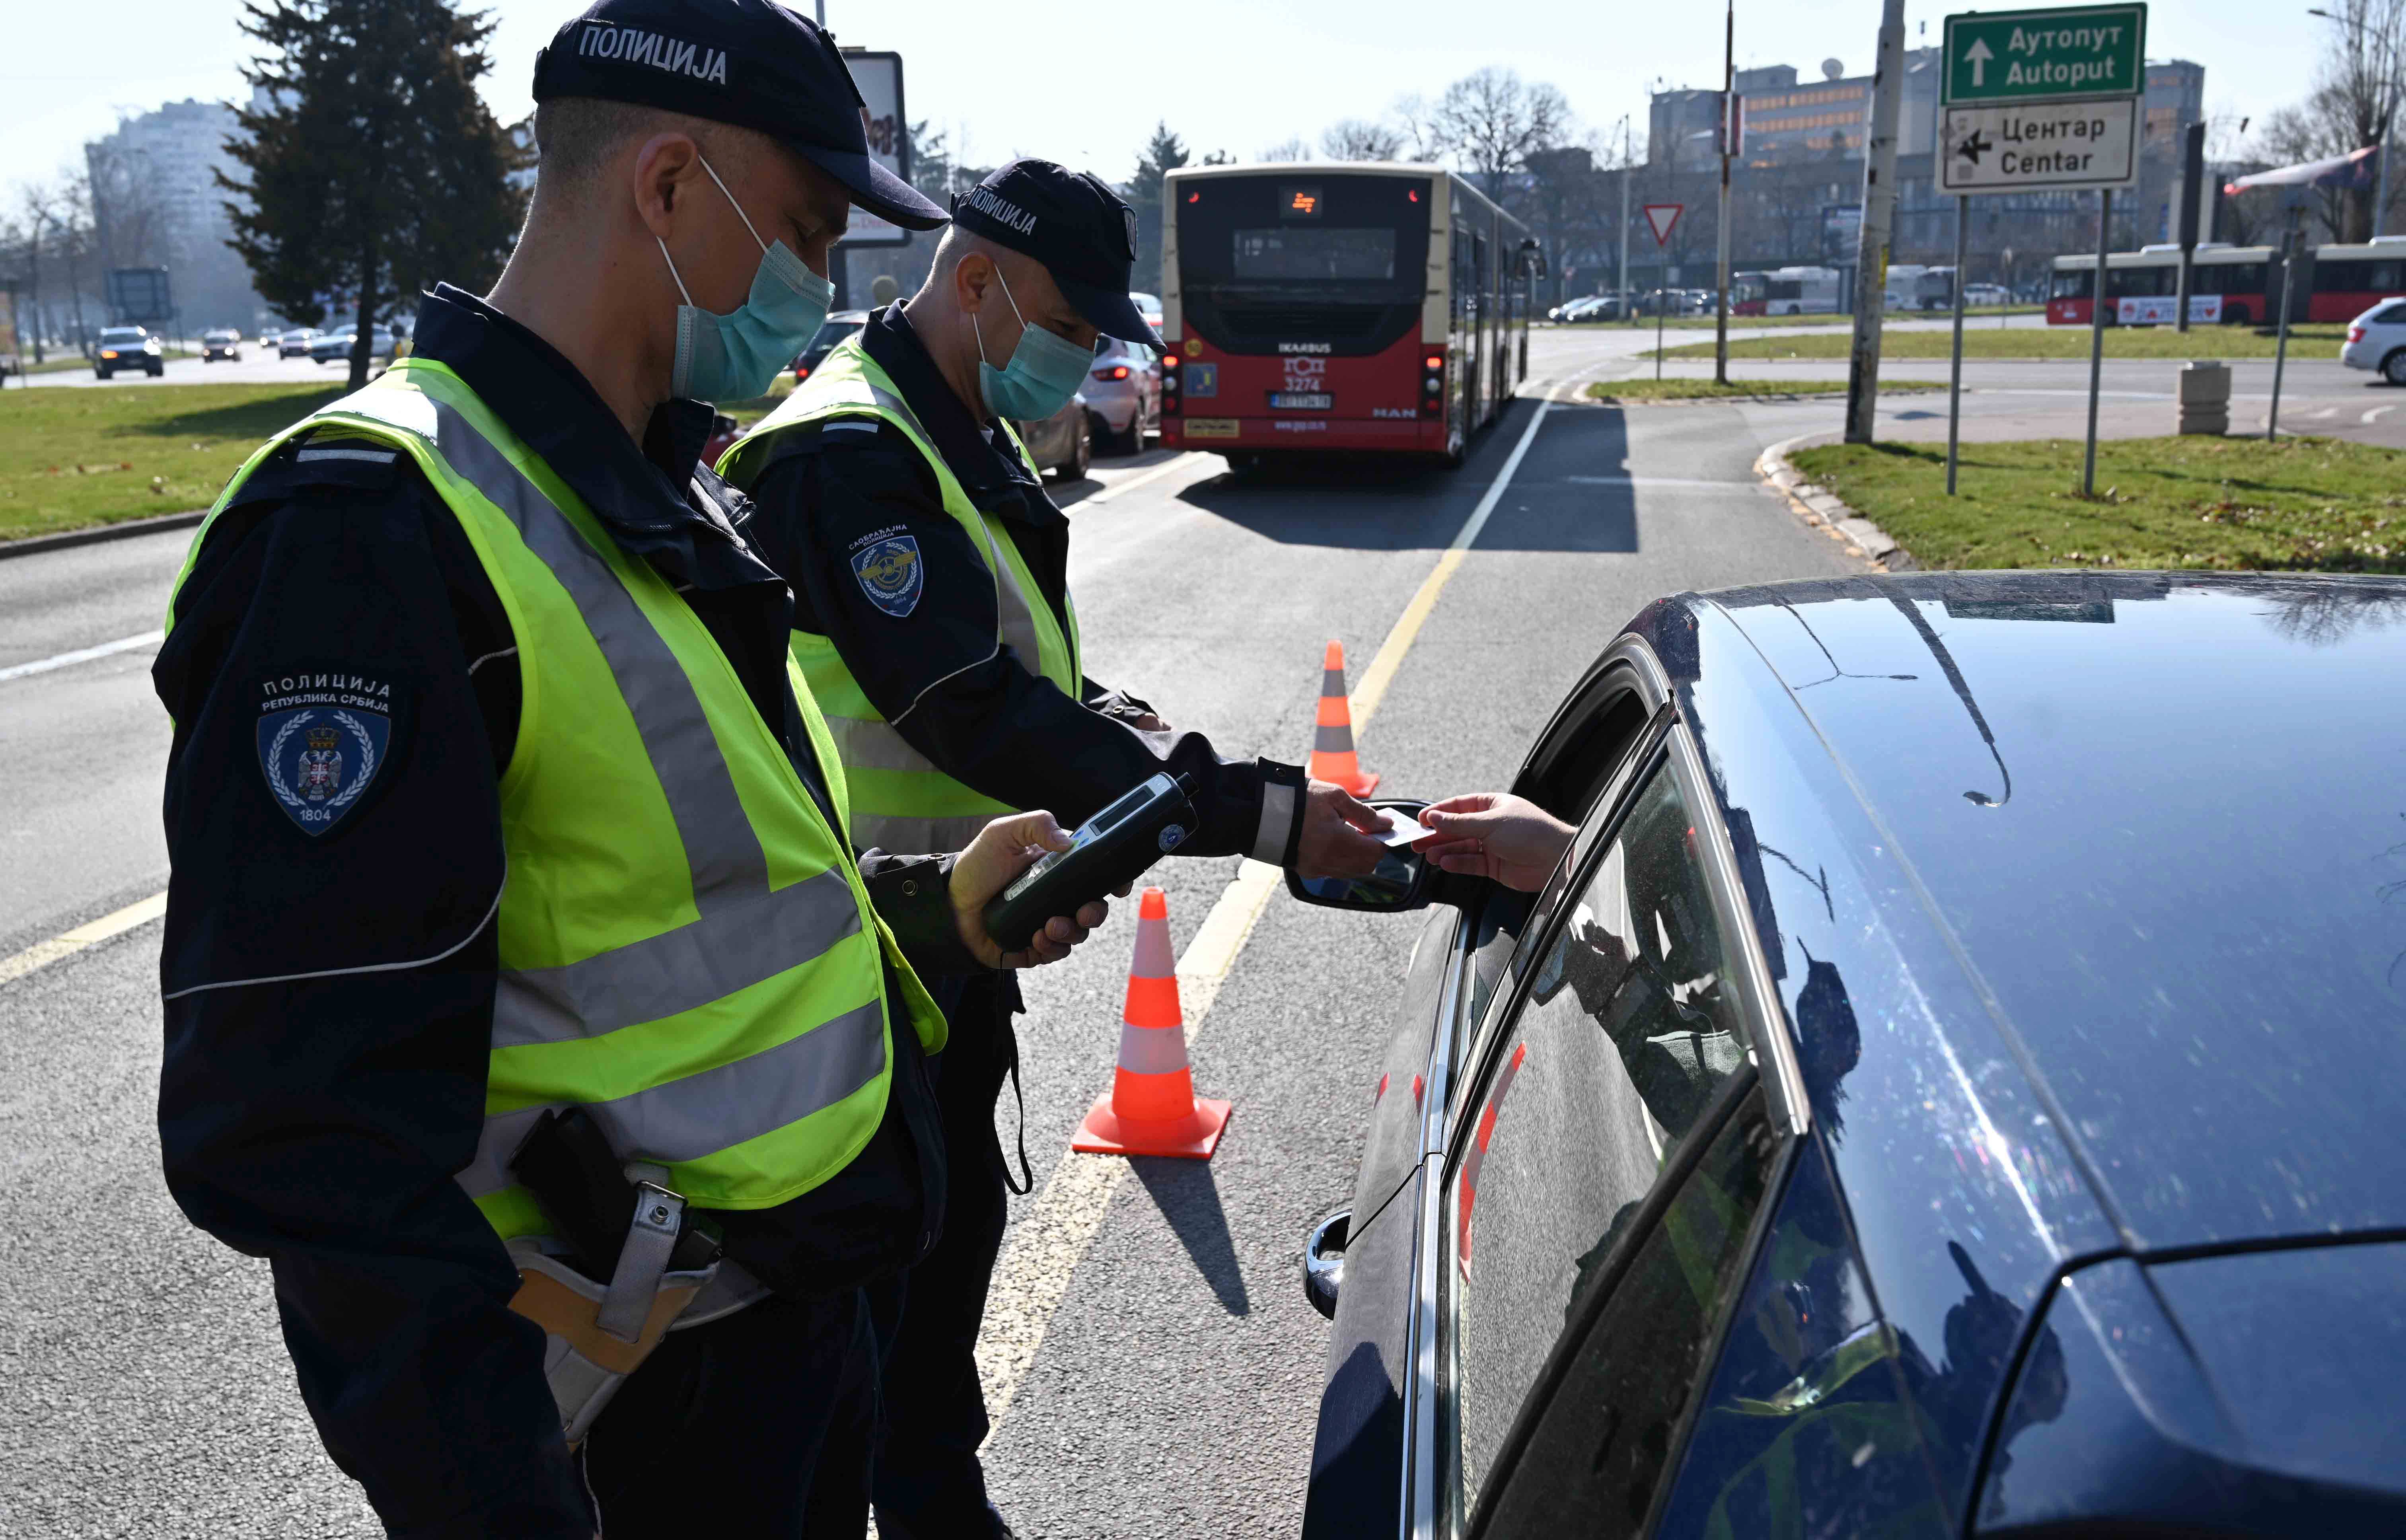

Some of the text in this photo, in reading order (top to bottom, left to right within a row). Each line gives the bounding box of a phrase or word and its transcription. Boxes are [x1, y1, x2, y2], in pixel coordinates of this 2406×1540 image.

[2008, 26, 2123, 56] Аутопут
[579, 25, 726, 85] ПОЛИЦИЈА
[2005, 55, 2115, 87] Autoput
[2003, 118, 2106, 143] Центар
[2001, 150, 2093, 174] Centar
[969, 188, 1037, 236] ПОЛИЦИЈА
[1278, 343, 1331, 354] IKARBUS
[849, 524, 907, 550] САОБРАЋАЈНА
[863, 532, 894, 547] ПОЛИЦИЈА
[263, 674, 390, 697] ПОЛИЦИЈА
[262, 693, 389, 713] РЕПУБЛИКА СРБИЈА
[300, 809, 331, 821] 1804
